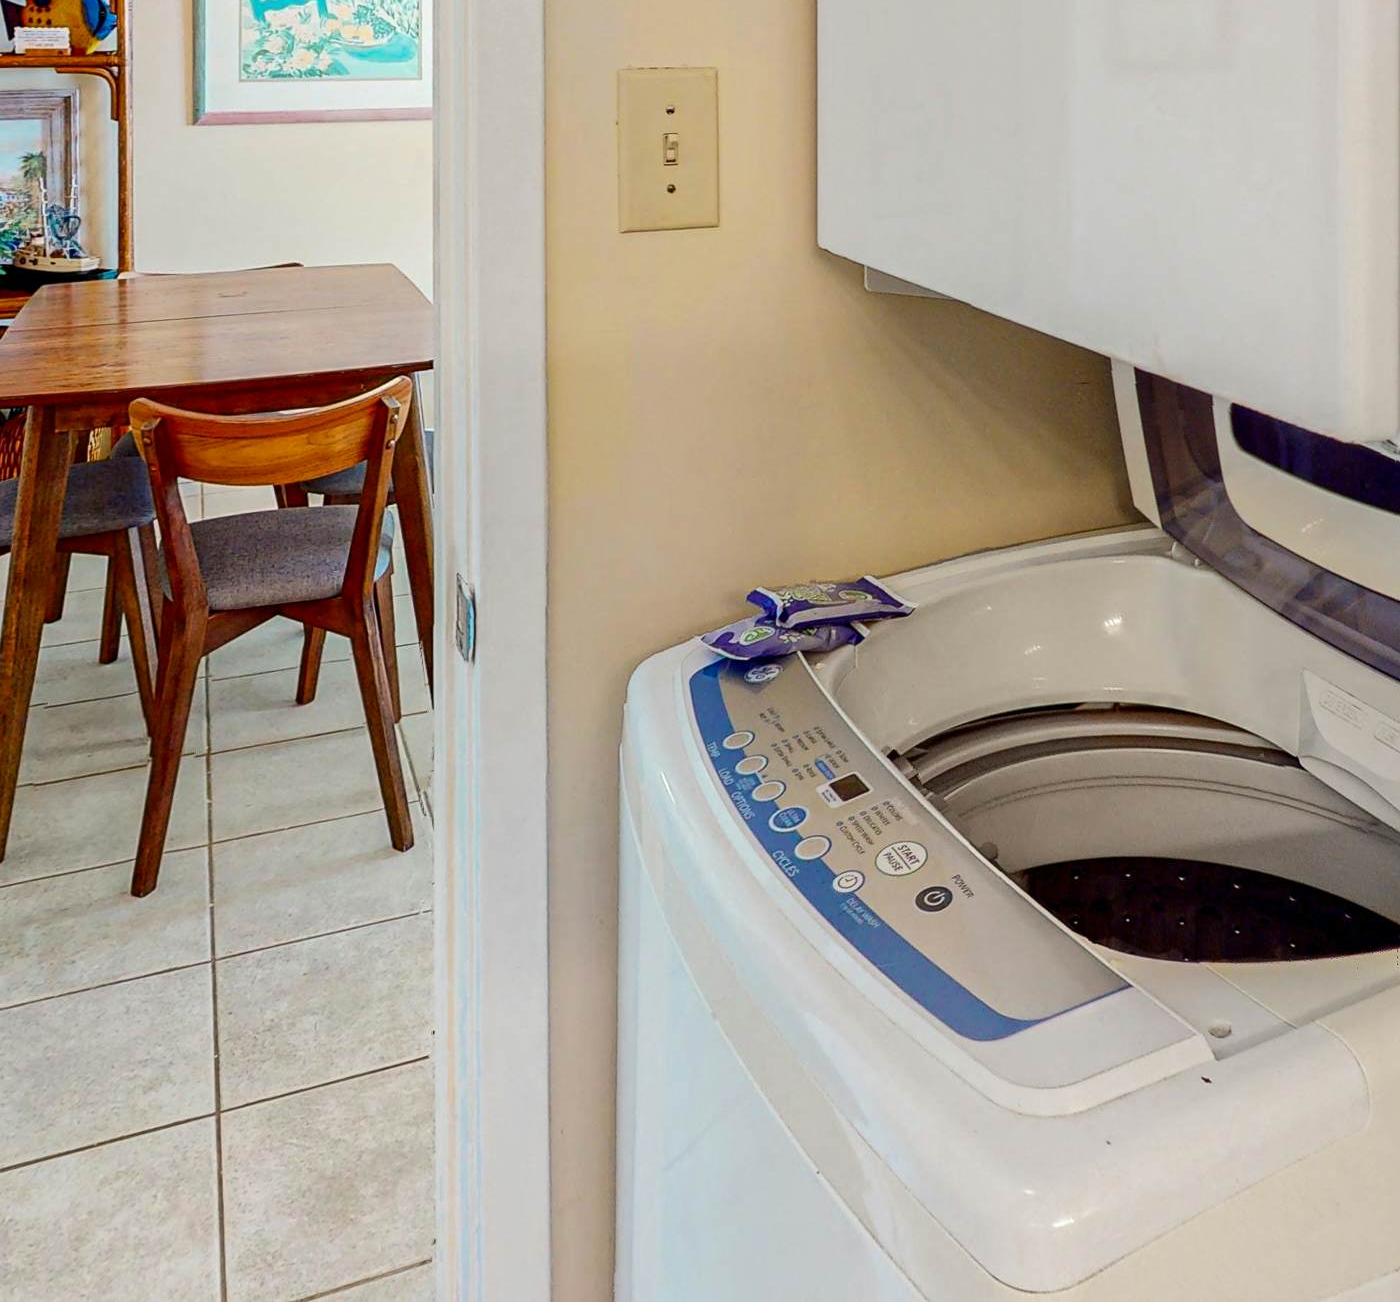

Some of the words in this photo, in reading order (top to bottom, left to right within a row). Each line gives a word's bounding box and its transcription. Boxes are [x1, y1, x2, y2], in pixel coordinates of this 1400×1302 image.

[706, 741, 721, 759] TEMP
[718, 767, 734, 786] LOAD
[731, 791, 756, 821] OPTIONS
[772, 850, 800, 877] CYCLES
[883, 852, 903, 872] PAUSE
[897, 844, 921, 866] START
[951, 874, 975, 899] POWER
